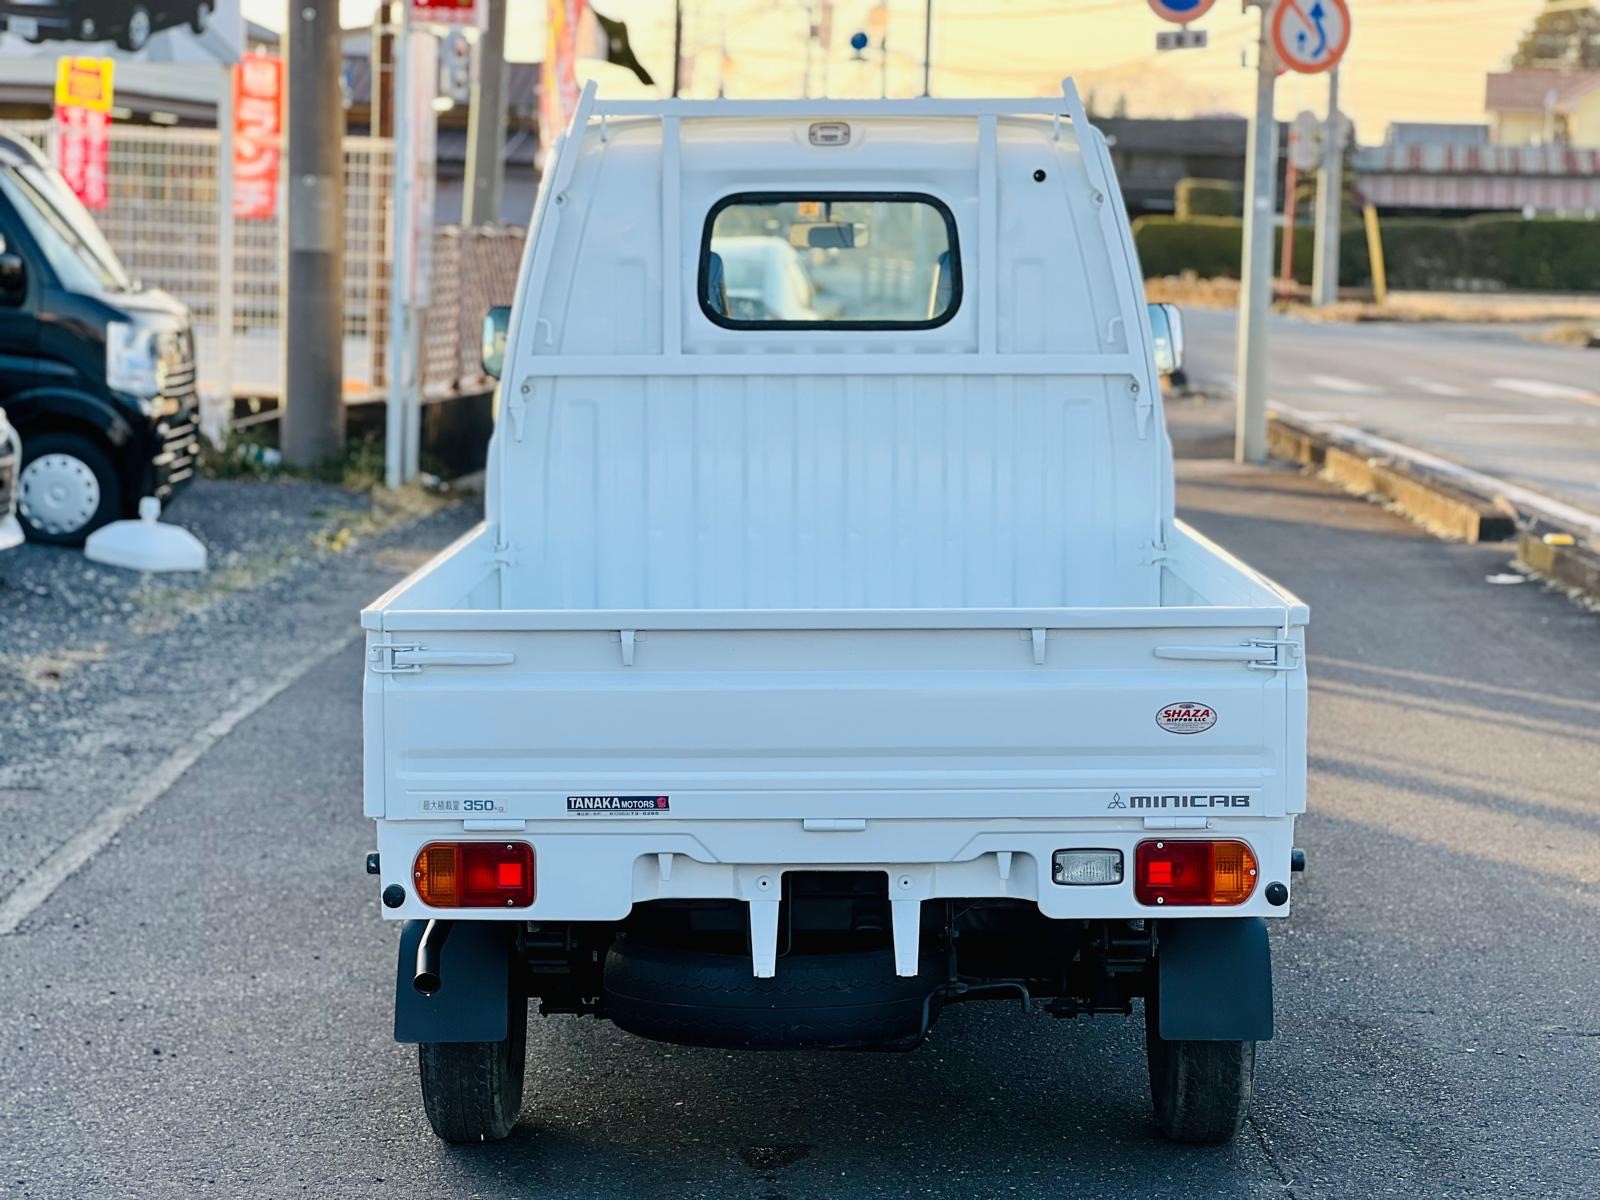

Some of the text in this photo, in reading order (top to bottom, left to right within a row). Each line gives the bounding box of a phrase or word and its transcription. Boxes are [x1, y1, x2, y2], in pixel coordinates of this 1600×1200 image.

[1163, 709, 1210, 718] SHAZA
[568, 797, 655, 809] TANAKA MOTORS
[1130, 795, 1250, 809] MINICAB
